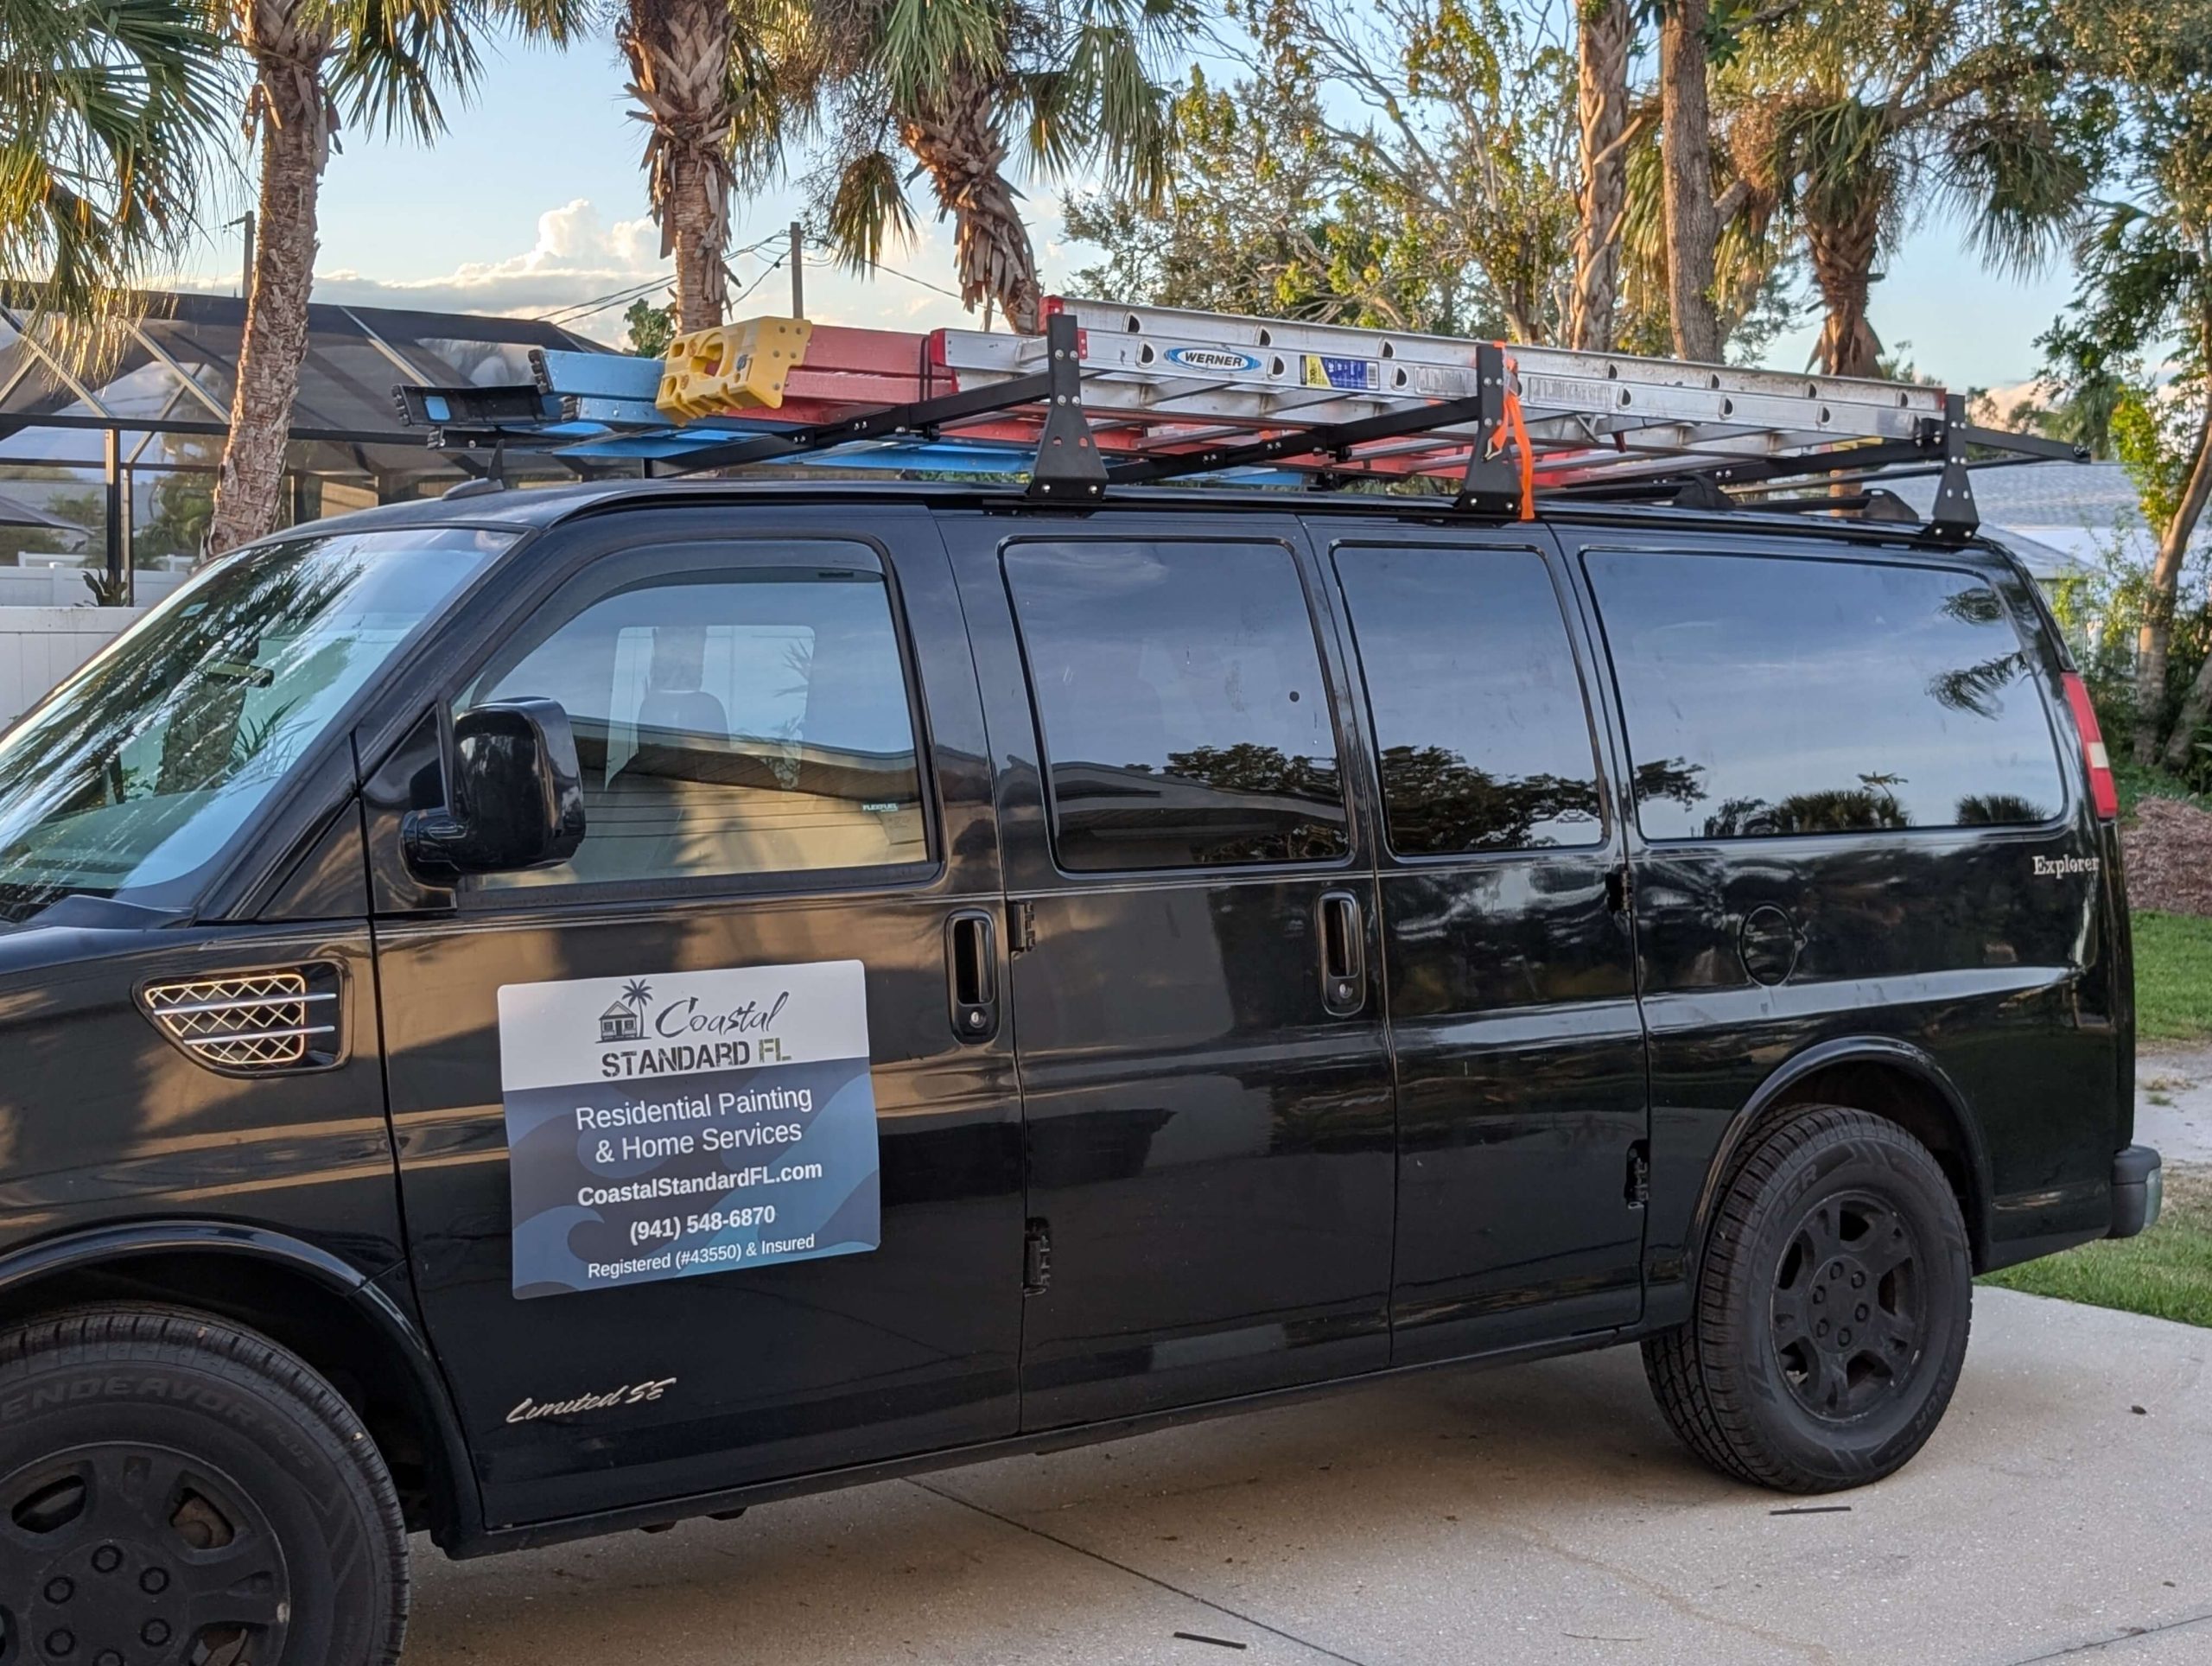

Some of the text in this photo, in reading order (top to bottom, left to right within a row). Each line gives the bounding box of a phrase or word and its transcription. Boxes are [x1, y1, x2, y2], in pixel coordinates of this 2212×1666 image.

[1185, 351, 1243, 367] WERNER
[2031, 853, 2100, 880] Explorer
[654, 991, 790, 1038] Coastal
[601, 1037, 791, 1078] STANDARD FL
[575, 1086, 812, 1131] Residential Painting
[594, 1122, 803, 1163] & Home Services
[577, 1162, 823, 1206] CoastalStandardFL.com
[630, 1205, 776, 1246] (941) 548-6870
[588, 1233, 815, 1279] Registered (#43550) & Insured
[1, 1375, 261, 1423] ENDEAVOR
[505, 1384, 629, 1423] Limited
